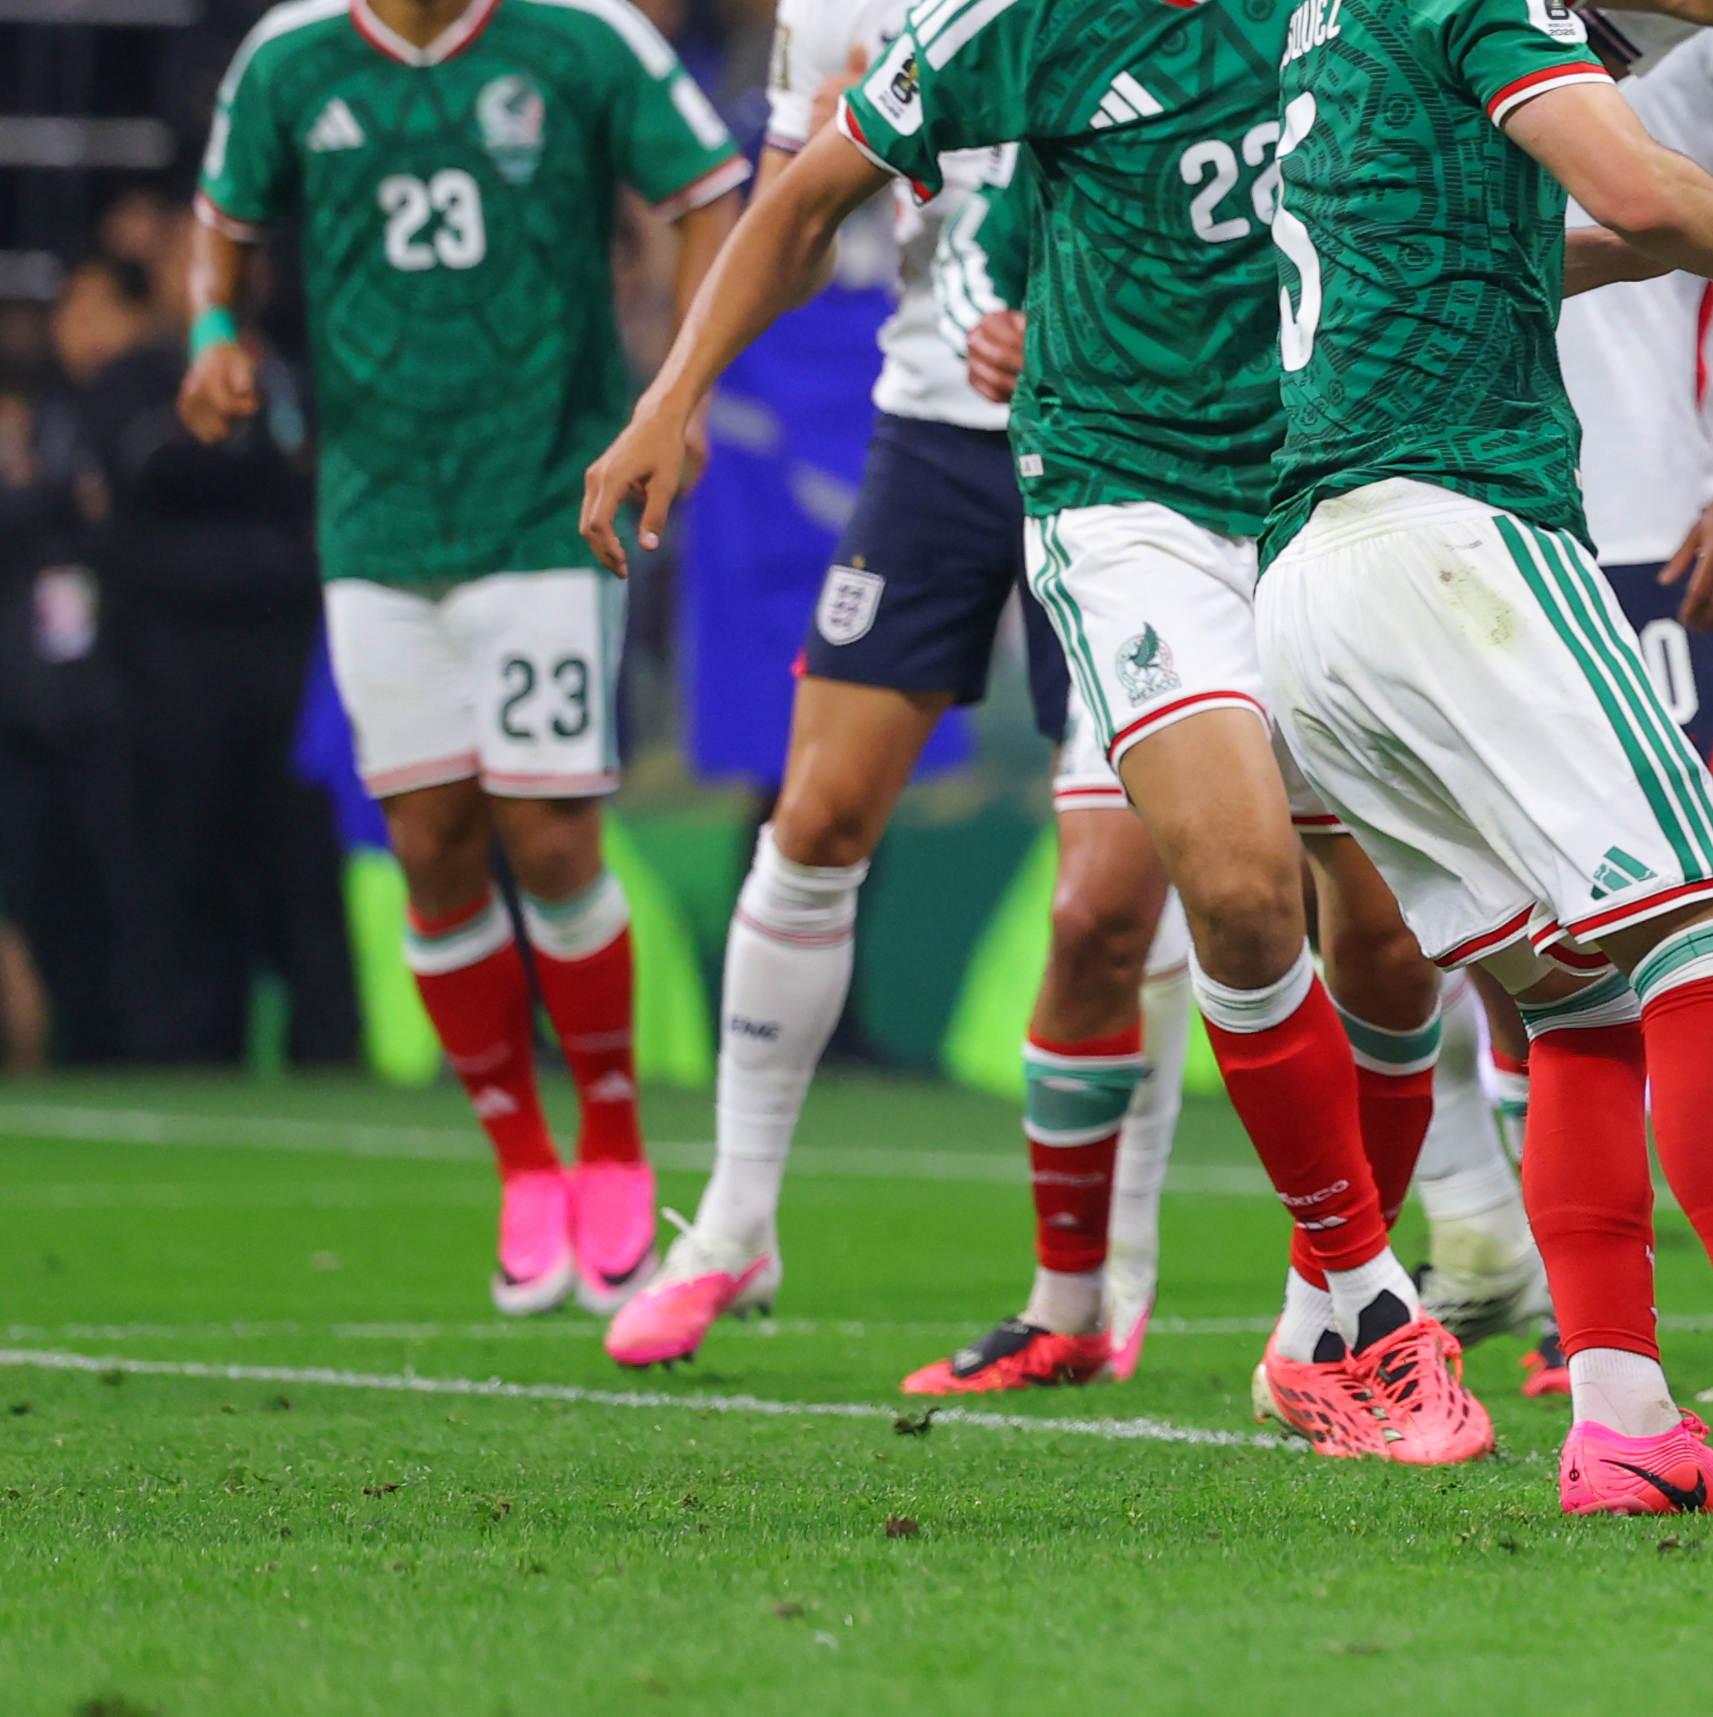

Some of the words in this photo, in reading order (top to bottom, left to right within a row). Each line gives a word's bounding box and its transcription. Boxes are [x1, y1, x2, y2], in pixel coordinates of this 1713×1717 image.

[378, 168, 487, 272] 23
[501, 657, 590, 739] 23
[1640, 617, 1699, 725] 0
